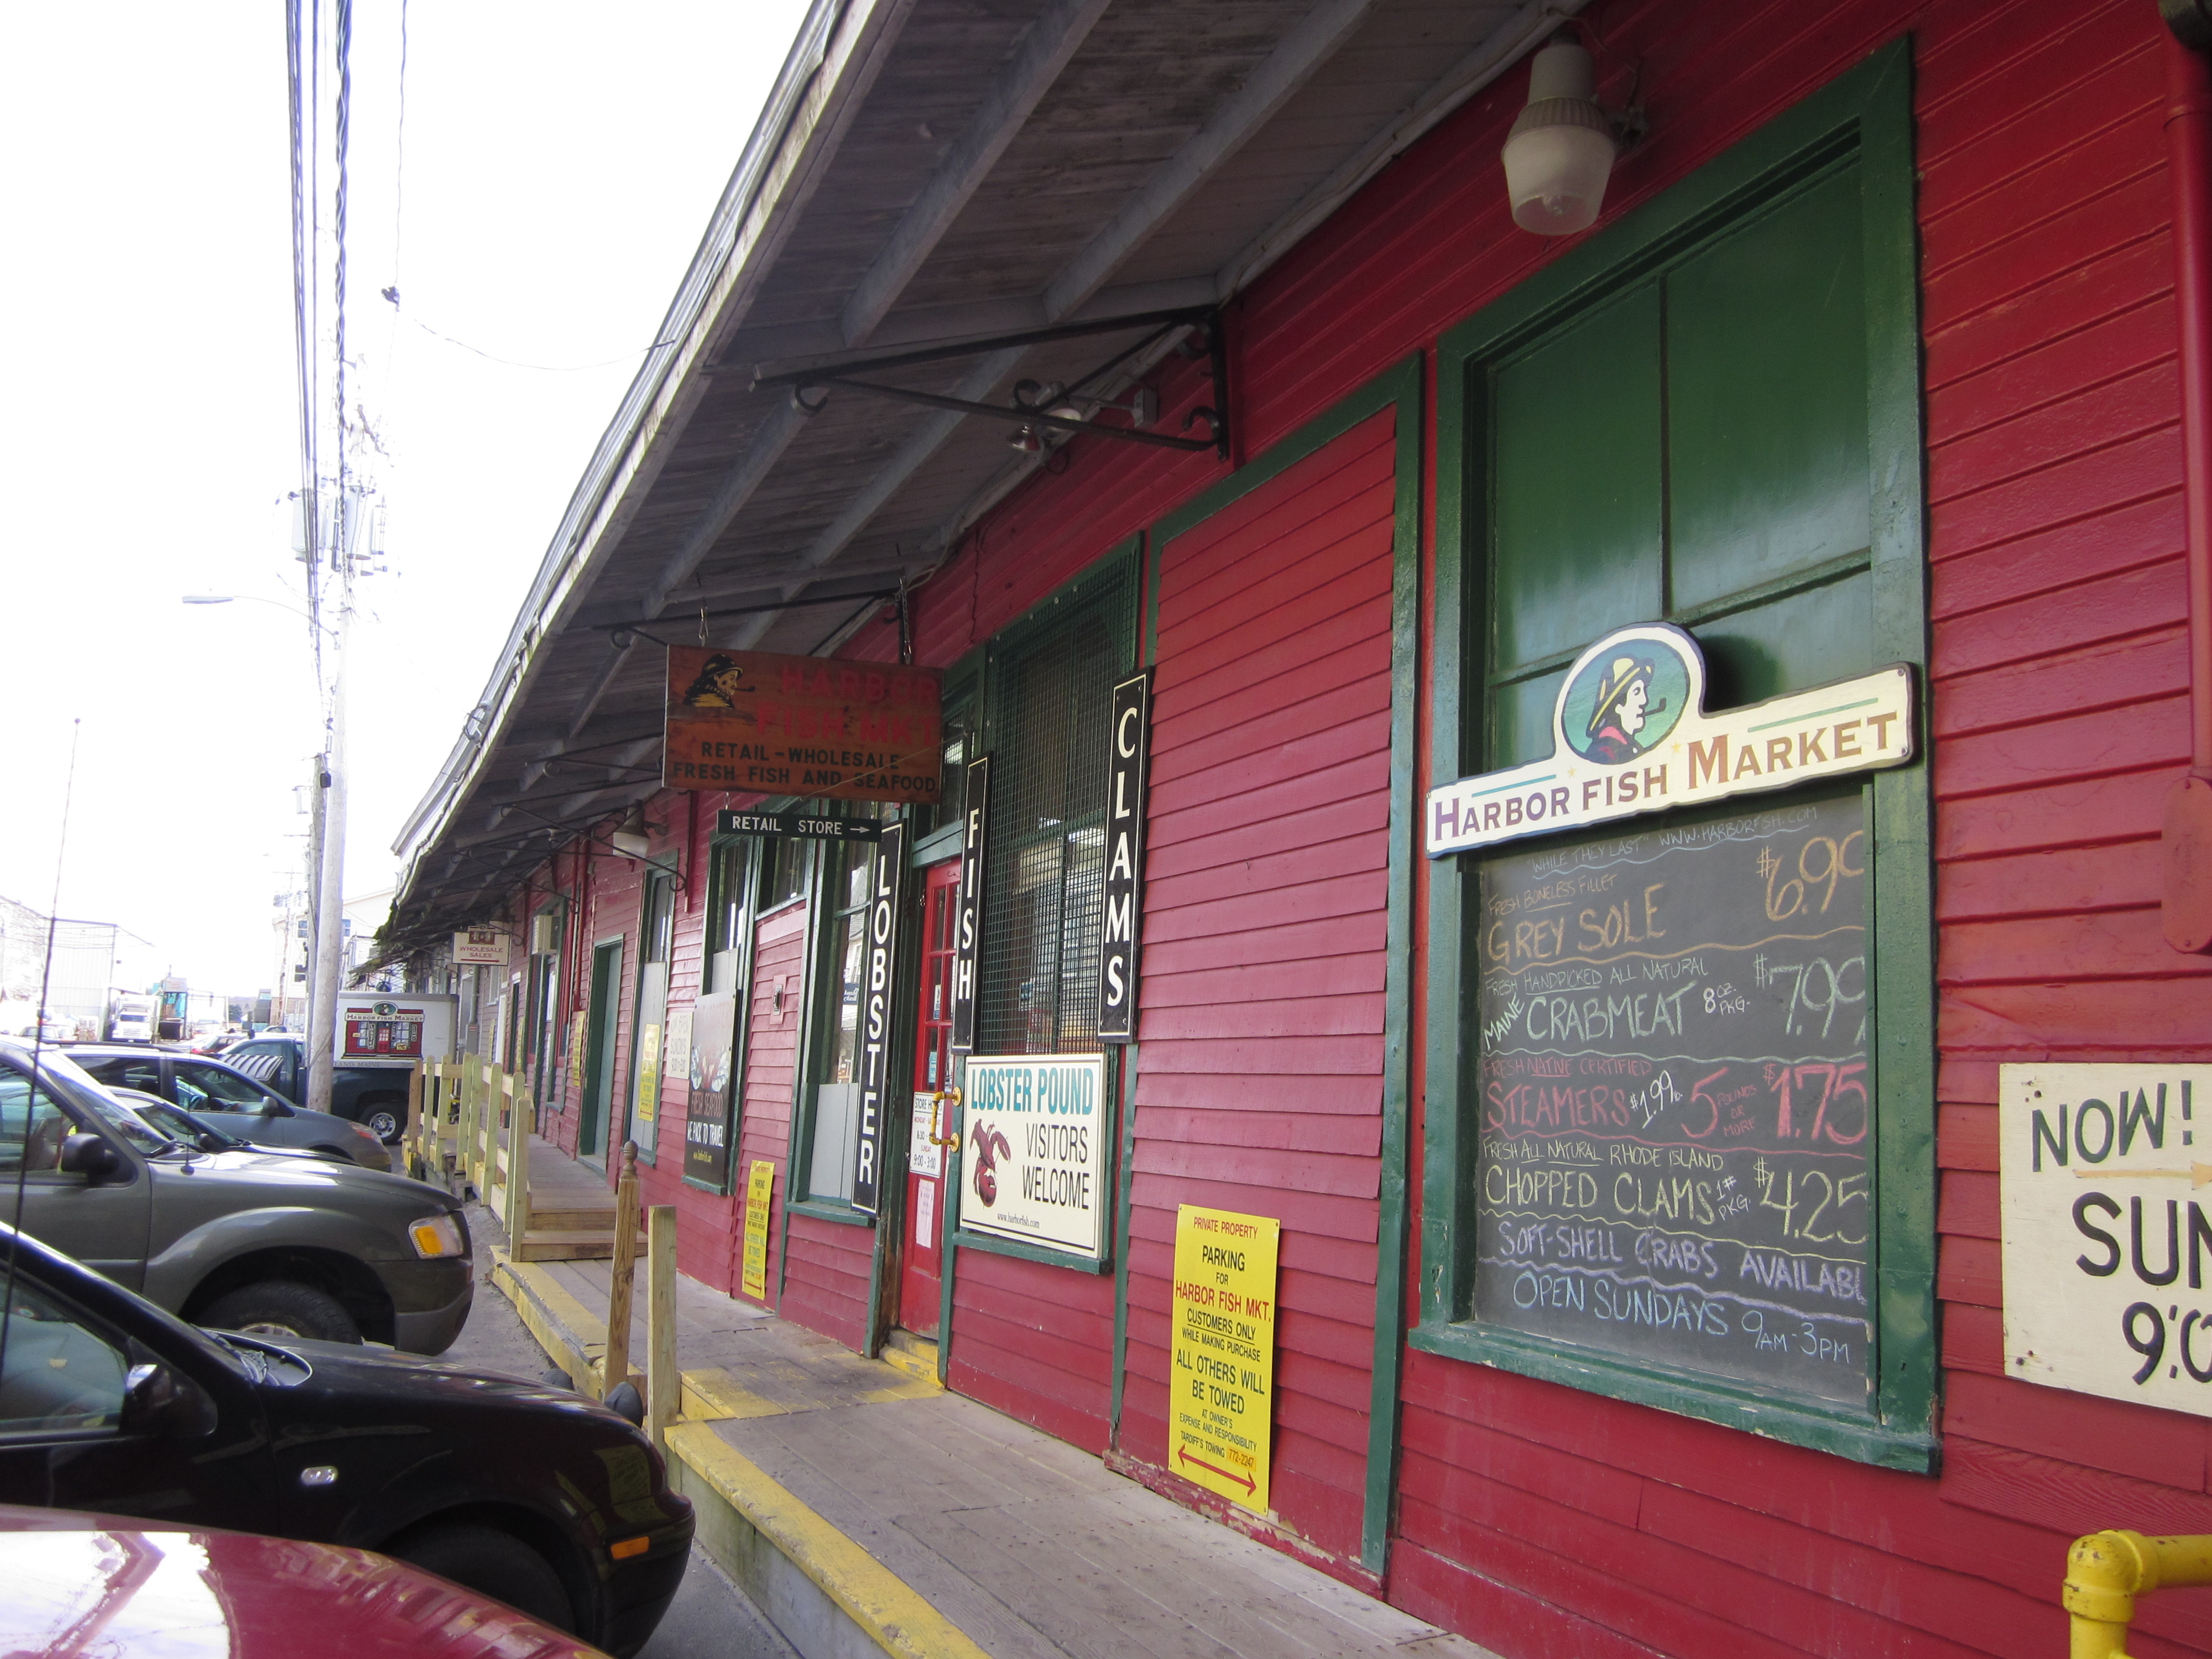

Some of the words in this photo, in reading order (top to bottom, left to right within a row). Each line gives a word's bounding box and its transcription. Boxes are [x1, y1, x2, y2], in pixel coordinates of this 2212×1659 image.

[757, 700, 845, 739] FISH
[702, 742, 770, 761] RETAIL
[789, 748, 900, 769] WHOLESALE
[674, 762, 735, 781] FRESH
[748, 766, 790, 784] FISH
[803, 769, 841, 786] AND
[854, 772, 936, 792] SEAFOOD
[1434, 785, 1570, 842] HARBOR
[1583, 764, 1668, 811] FISH
[1688, 712, 1897, 790] MARKET
[732, 815, 782, 832] RETAIL
[797, 820, 843, 835] STORE
[1105, 707, 1138, 1006] CLAMS
[1574, 844, 1605, 862] THEY
[958, 808, 980, 1000] FISH
[1488, 893, 1520, 916] FRESH
[1524, 880, 1575, 909] BONELESS
[1578, 874, 1617, 893] FILLET
[1488, 916, 1565, 964] GREY
[1577, 881, 1667, 952] SOLE
[1485, 978, 1518, 996] FRESH
[1523, 968, 1602, 992] HANDPICKED
[1610, 964, 1637, 985] ALL
[1643, 957, 1708, 981] NATURAL
[858, 854, 891, 1185] LOBSTER
[1484, 992, 1525, 1051] MAINE
[1526, 979, 1698, 1043] CRABMEAT
[1703, 988, 1716, 1014] 8
[1483, 1058, 1524, 1078] FRESH
[1527, 1057, 1573, 1075] NATIVE
[1580, 1057, 1652, 1076] CERTIFIED
[915, 1098, 926, 1109] STORE
[971, 1068, 1032, 1113] LOBSTER
[1038, 1067, 1093, 1115] POUND
[1486, 1081, 1631, 1128] STEAMERS
[1681, 1067, 1730, 1139] 5
[1717, 1084, 1757, 1107] POUNDS
[1762, 1062, 1867, 1145] $1.75
[1723, 1118, 1755, 1137] MORE
[1730, 1105, 1745, 1119] OR
[2032, 1079, 2193, 1173] NOW!
[914, 1154, 923, 1167] 9:00
[927, 1156, 936, 1170] 3:00
[1026, 1123, 1088, 1164] VISITORS
[1483, 1135, 1519, 1160] FRESH
[1521, 1138, 1545, 1158] ALL
[1548, 1139, 1604, 1161] NATURAL
[1610, 1144, 1665, 1167] RHODE
[1669, 1147, 1724, 1171] ISLAND
[1022, 1164, 1089, 1210] WELCOME
[1486, 1165, 1598, 1208] CHOPPED
[1614, 1172, 1715, 1225] CLAMS
[997, 1212, 1040, 1229] www.harborfish.com
[1193, 1217, 1218, 1233] PRIVATE
[1220, 1221, 1258, 1239] PROPERTY
[1202, 1245, 1245, 1272] PARKING
[1635, 1232, 1719, 1280] CRABS
[1216, 1272, 1229, 1286] FOR
[1176, 1280, 1215, 1307] HARBOR
[1218, 1291, 1241, 1314] FISH
[1246, 1297, 1271, 1322] MKT.
[1514, 1271, 1585, 1313] OPEN
[1594, 1279, 1729, 1336] SUNDAYS
[1187, 1308, 1233, 1334] CUSTOMERS
[1236, 1322, 1256, 1340] ONLY
[1182, 1327, 1199, 1343] WHILE
[1201, 1333, 1225, 1351] MAKING
[1227, 1341, 1261, 1362] PURCHASE
[1176, 1348, 1193, 1370] ALL
[1197, 1355, 1236, 1385] OTHERS
[1240, 1368, 1265, 1395] WILL
[1192, 1379, 1204, 1400] BE
[1208, 1384, 1245, 1415] TOWED
[1180, 1412, 1201, 1430] EXPENSE
[1202, 1422, 1213, 1434] AND
[1215, 1427, 1257, 1452] RESPONSIBILITY
[1201, 1408, 1208, 1419] AT
[1209, 1411, 1233, 1429] OWNER'S
[1206, 1441, 1225, 1458] TOWING
[1229, 1448, 1254, 1468] 772-2247
